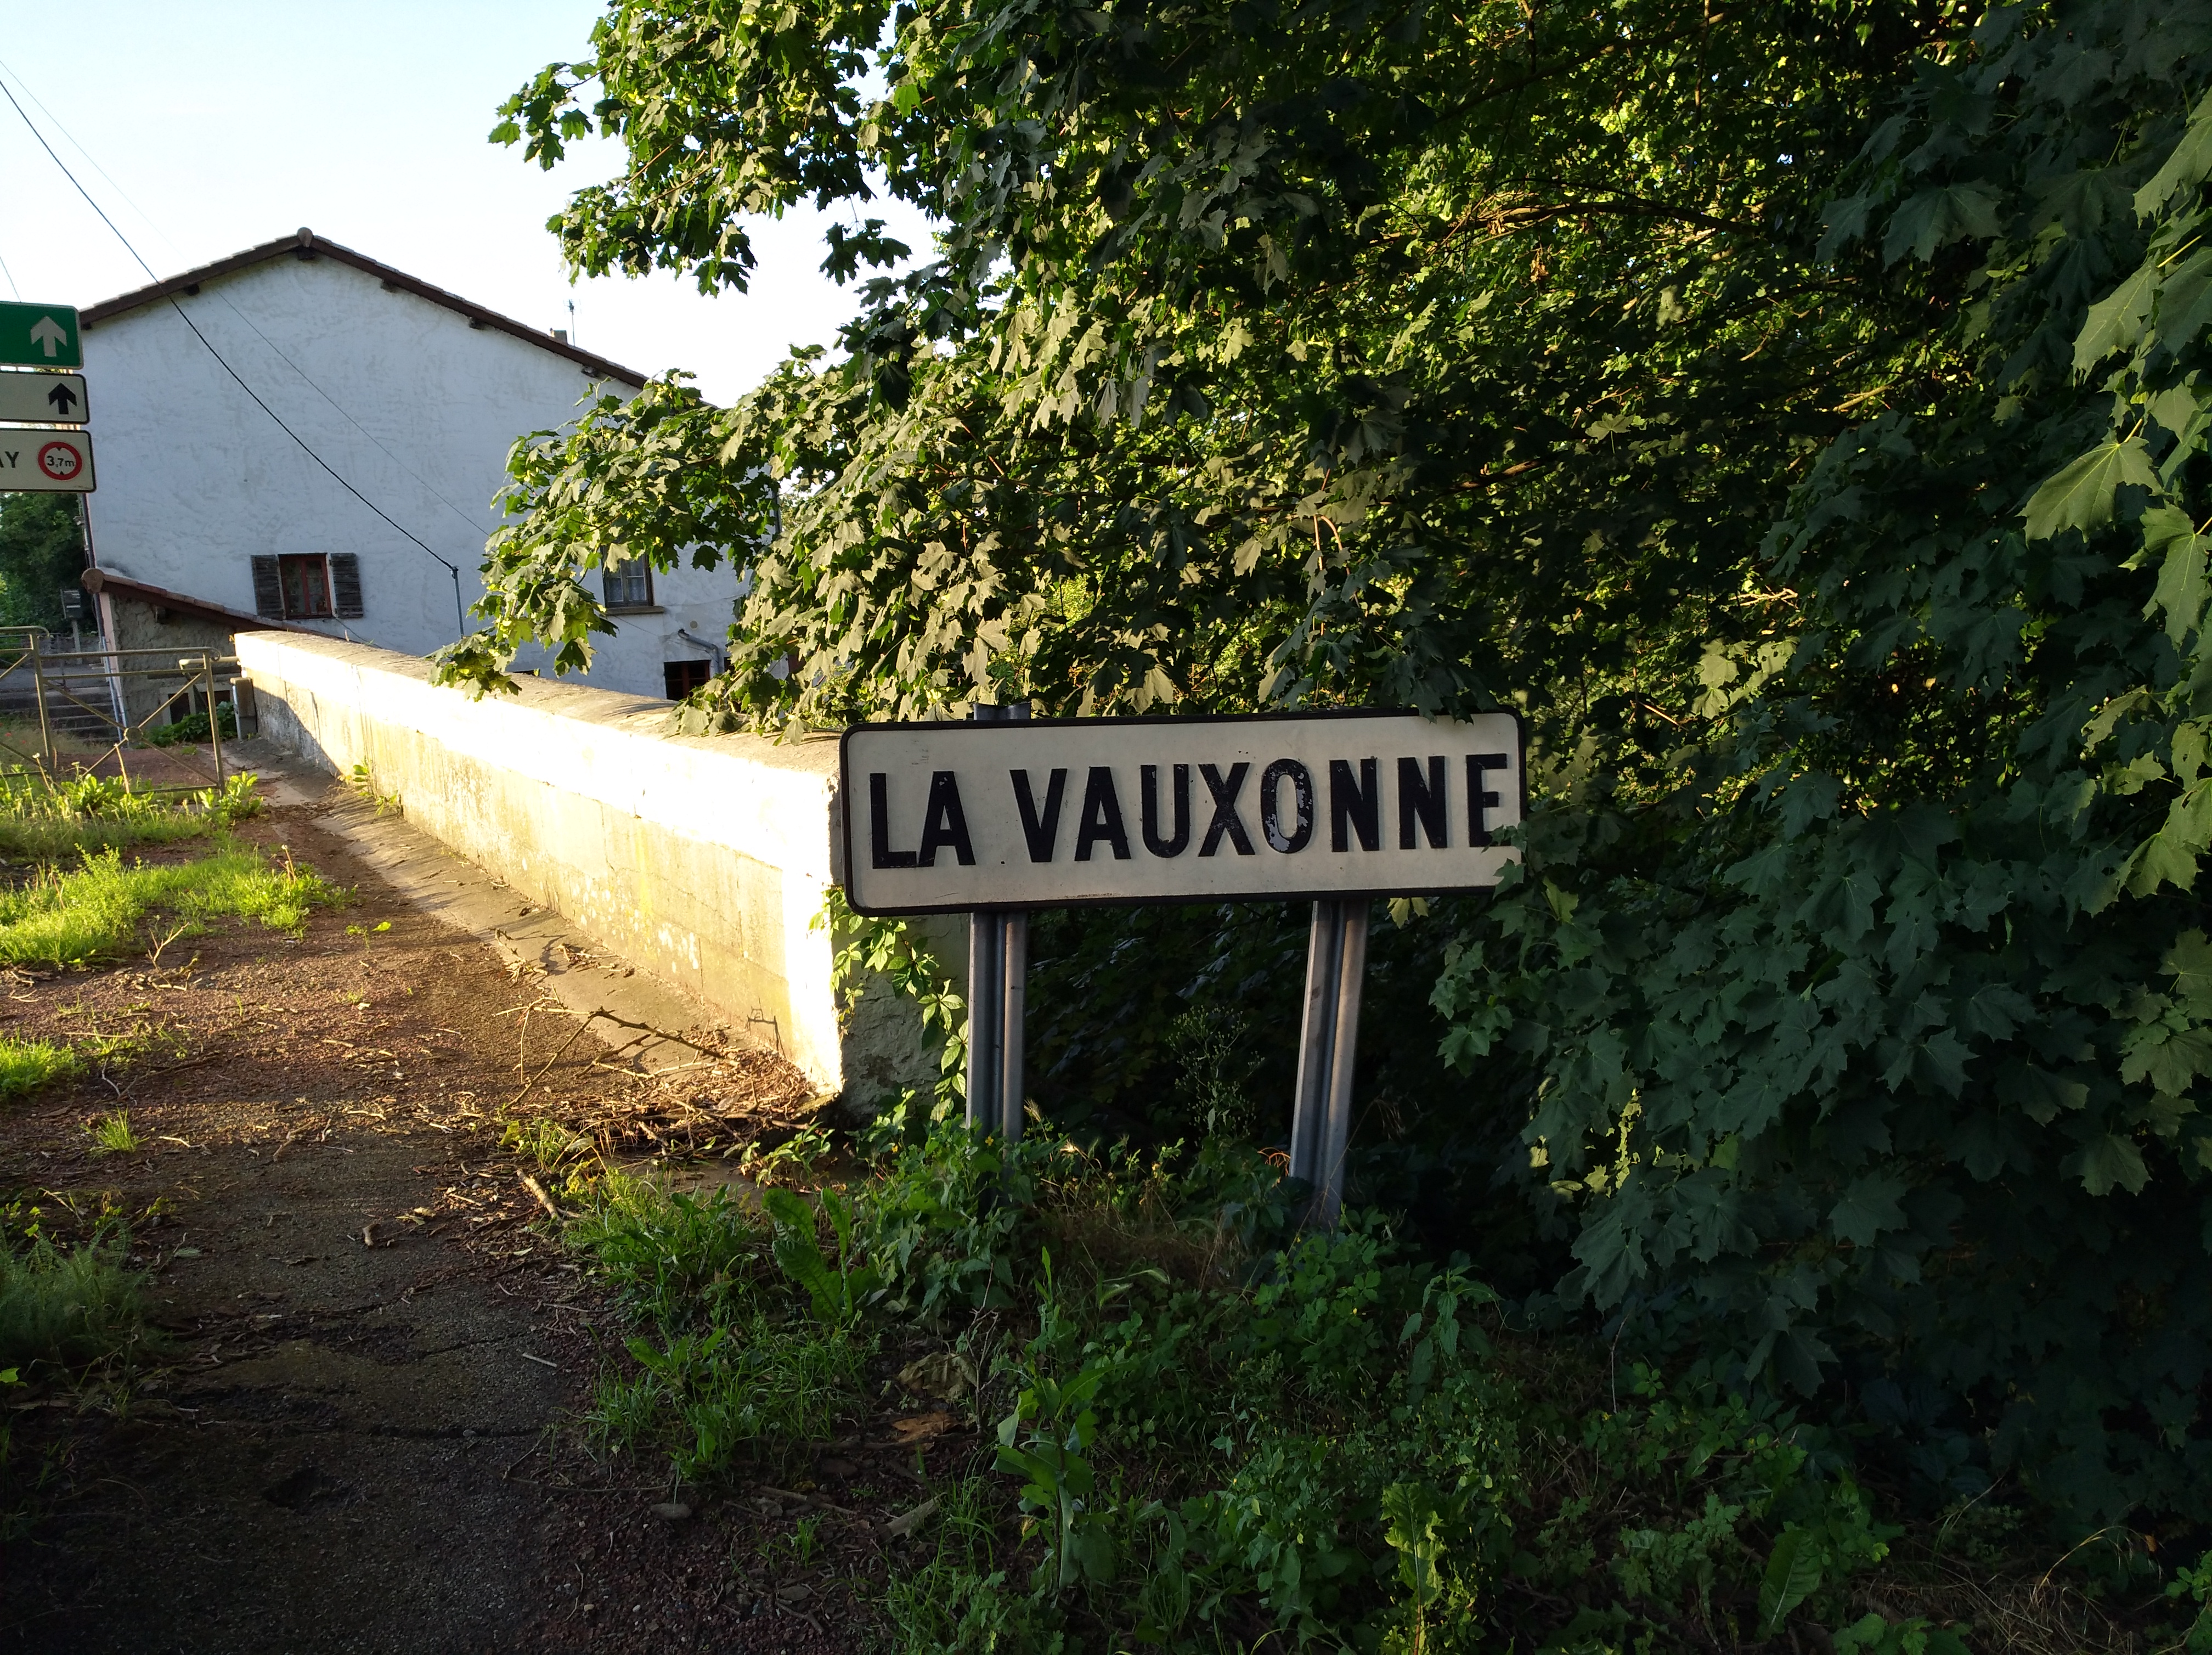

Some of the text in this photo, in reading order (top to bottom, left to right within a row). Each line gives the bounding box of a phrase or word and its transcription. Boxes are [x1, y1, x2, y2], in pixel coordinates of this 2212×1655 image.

[0, 451, 19, 468] Y
[870, 753, 1511, 869] LA VAUXONNE
